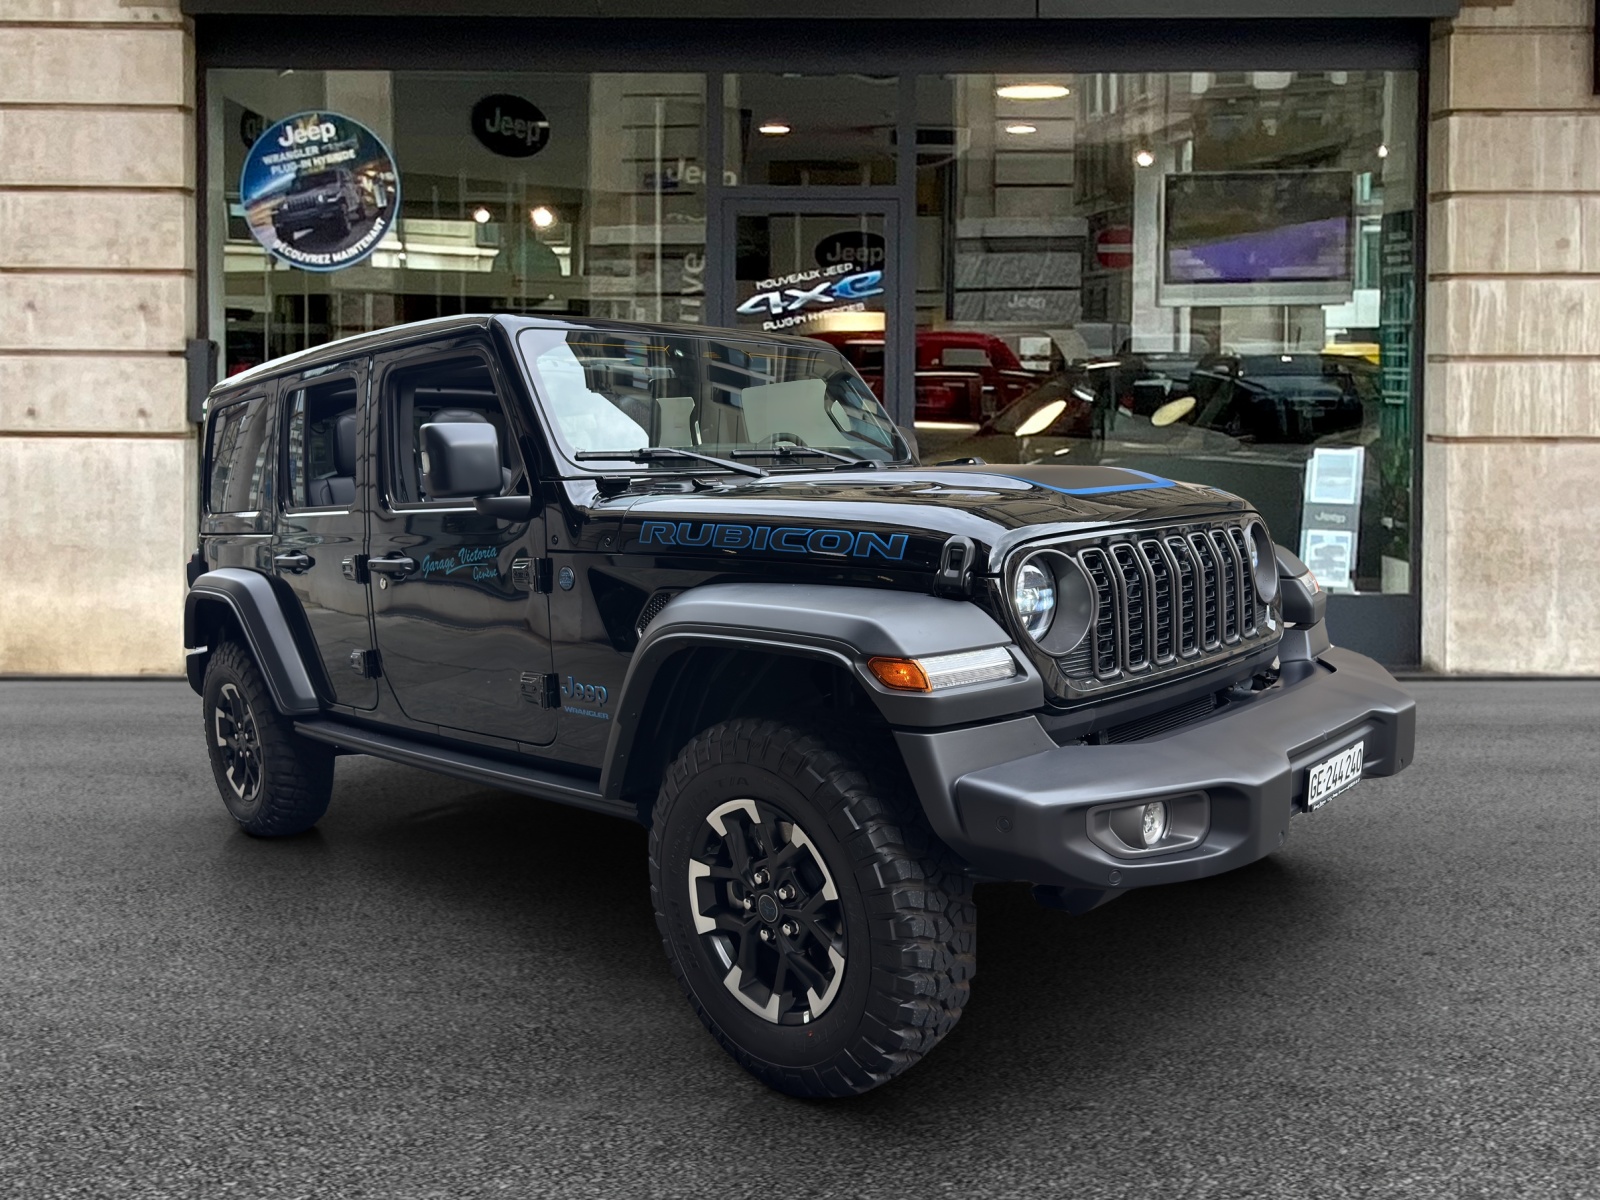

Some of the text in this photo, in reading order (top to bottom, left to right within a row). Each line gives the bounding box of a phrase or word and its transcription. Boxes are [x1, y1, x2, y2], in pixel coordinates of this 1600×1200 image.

[278, 122, 337, 147] Jeep
[485, 107, 541, 146] Jeep
[262, 145, 320, 165] WRANGLER
[332, 216, 386, 262] MAINTENANT
[826, 242, 885, 267] Jeep
[755, 262, 854, 290] NOUVEAUX JEEP
[1315, 511, 1346, 524] Jeep
[638, 521, 909, 560] RUBICON
[422, 546, 498, 579] Garage Victoria
[560, 674, 608, 706] Jeep
[563, 705, 609, 720] WRANGLER
